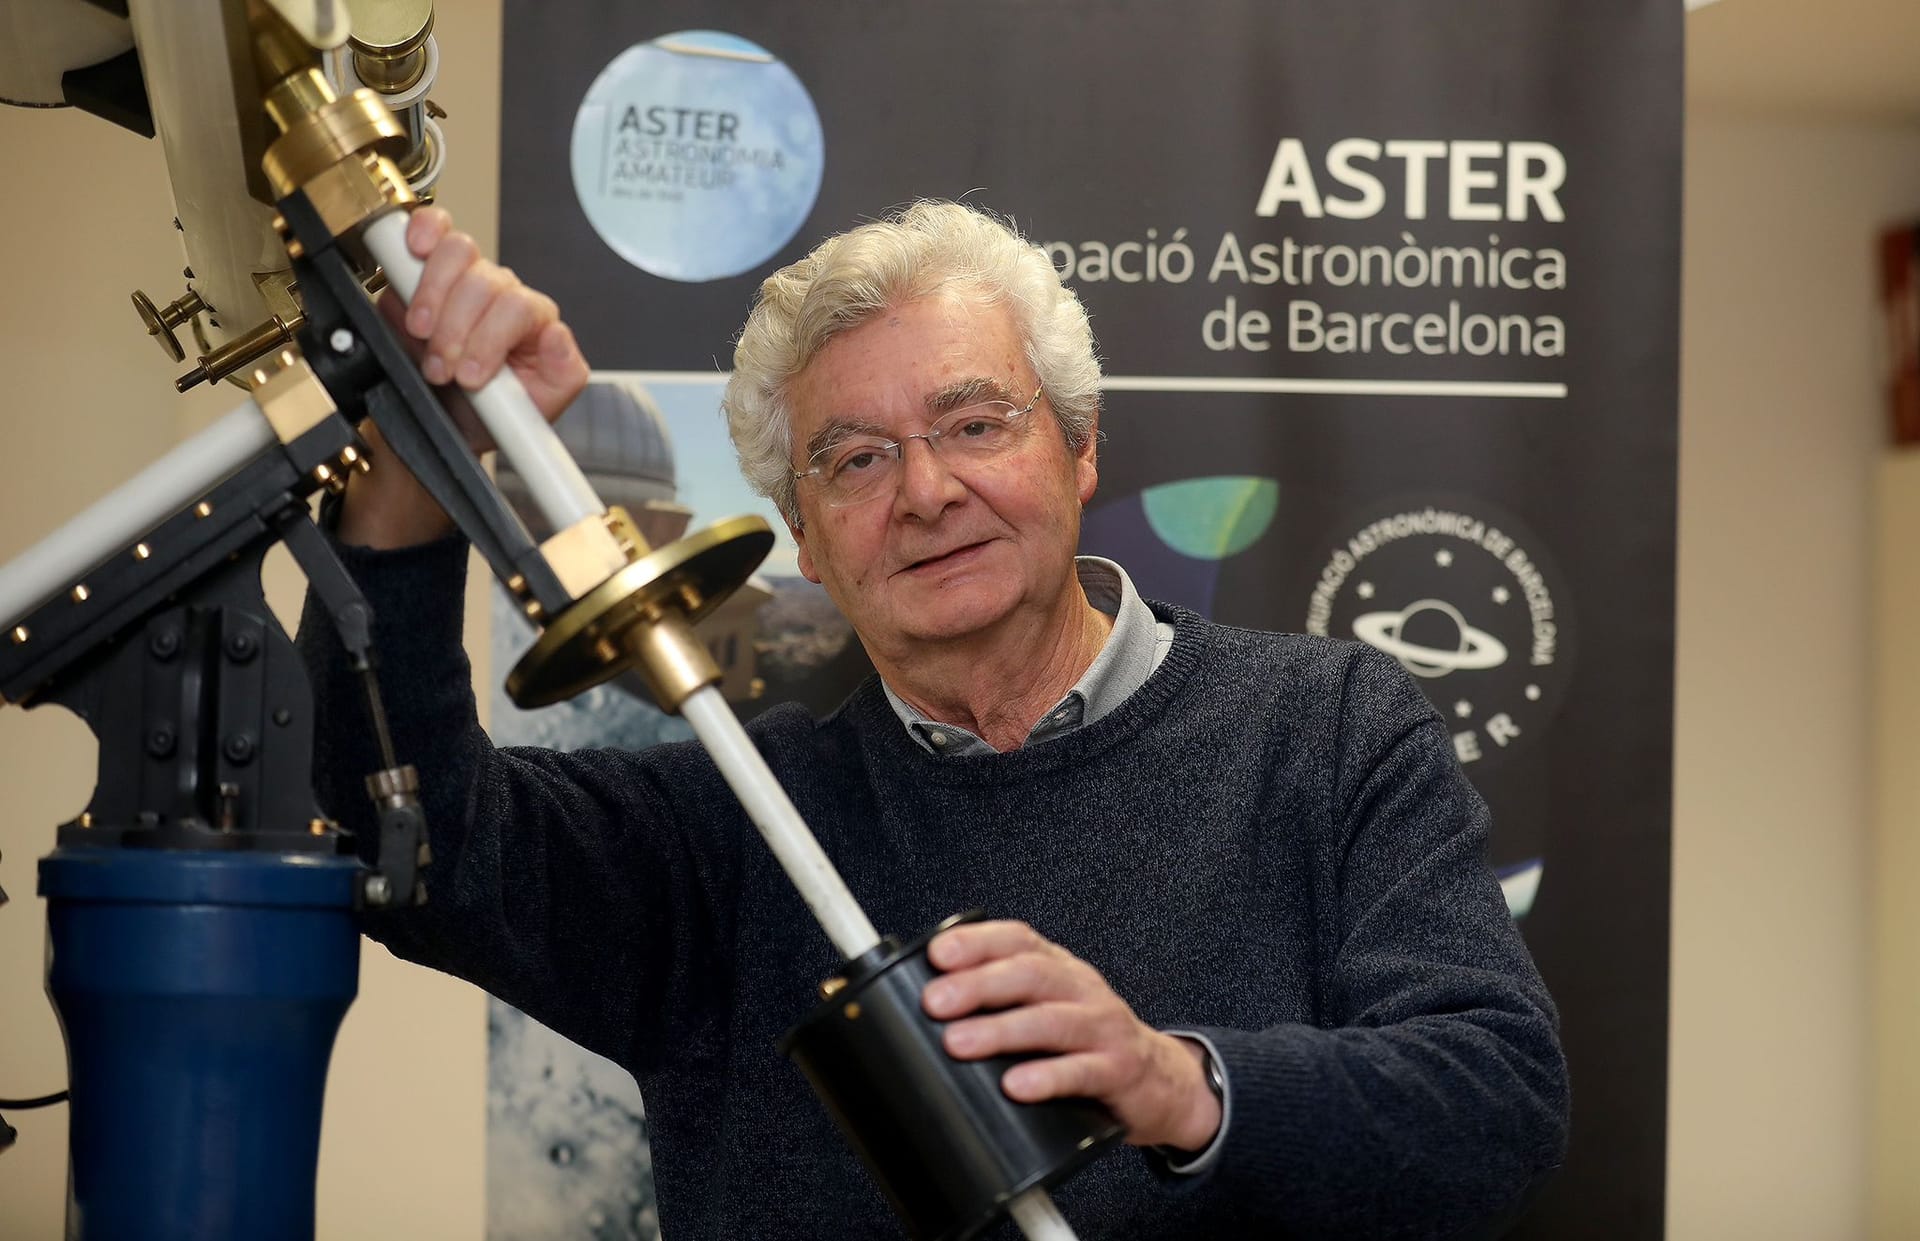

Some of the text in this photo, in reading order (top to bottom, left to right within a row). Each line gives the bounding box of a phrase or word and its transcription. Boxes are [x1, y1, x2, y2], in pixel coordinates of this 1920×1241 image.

[618, 104, 740, 142] ASTER
[1255, 137, 1567, 222] ASTER
[1034, 226, 1567, 291] pació Astronòmica
[1201, 296, 1567, 358] de Barcelona
